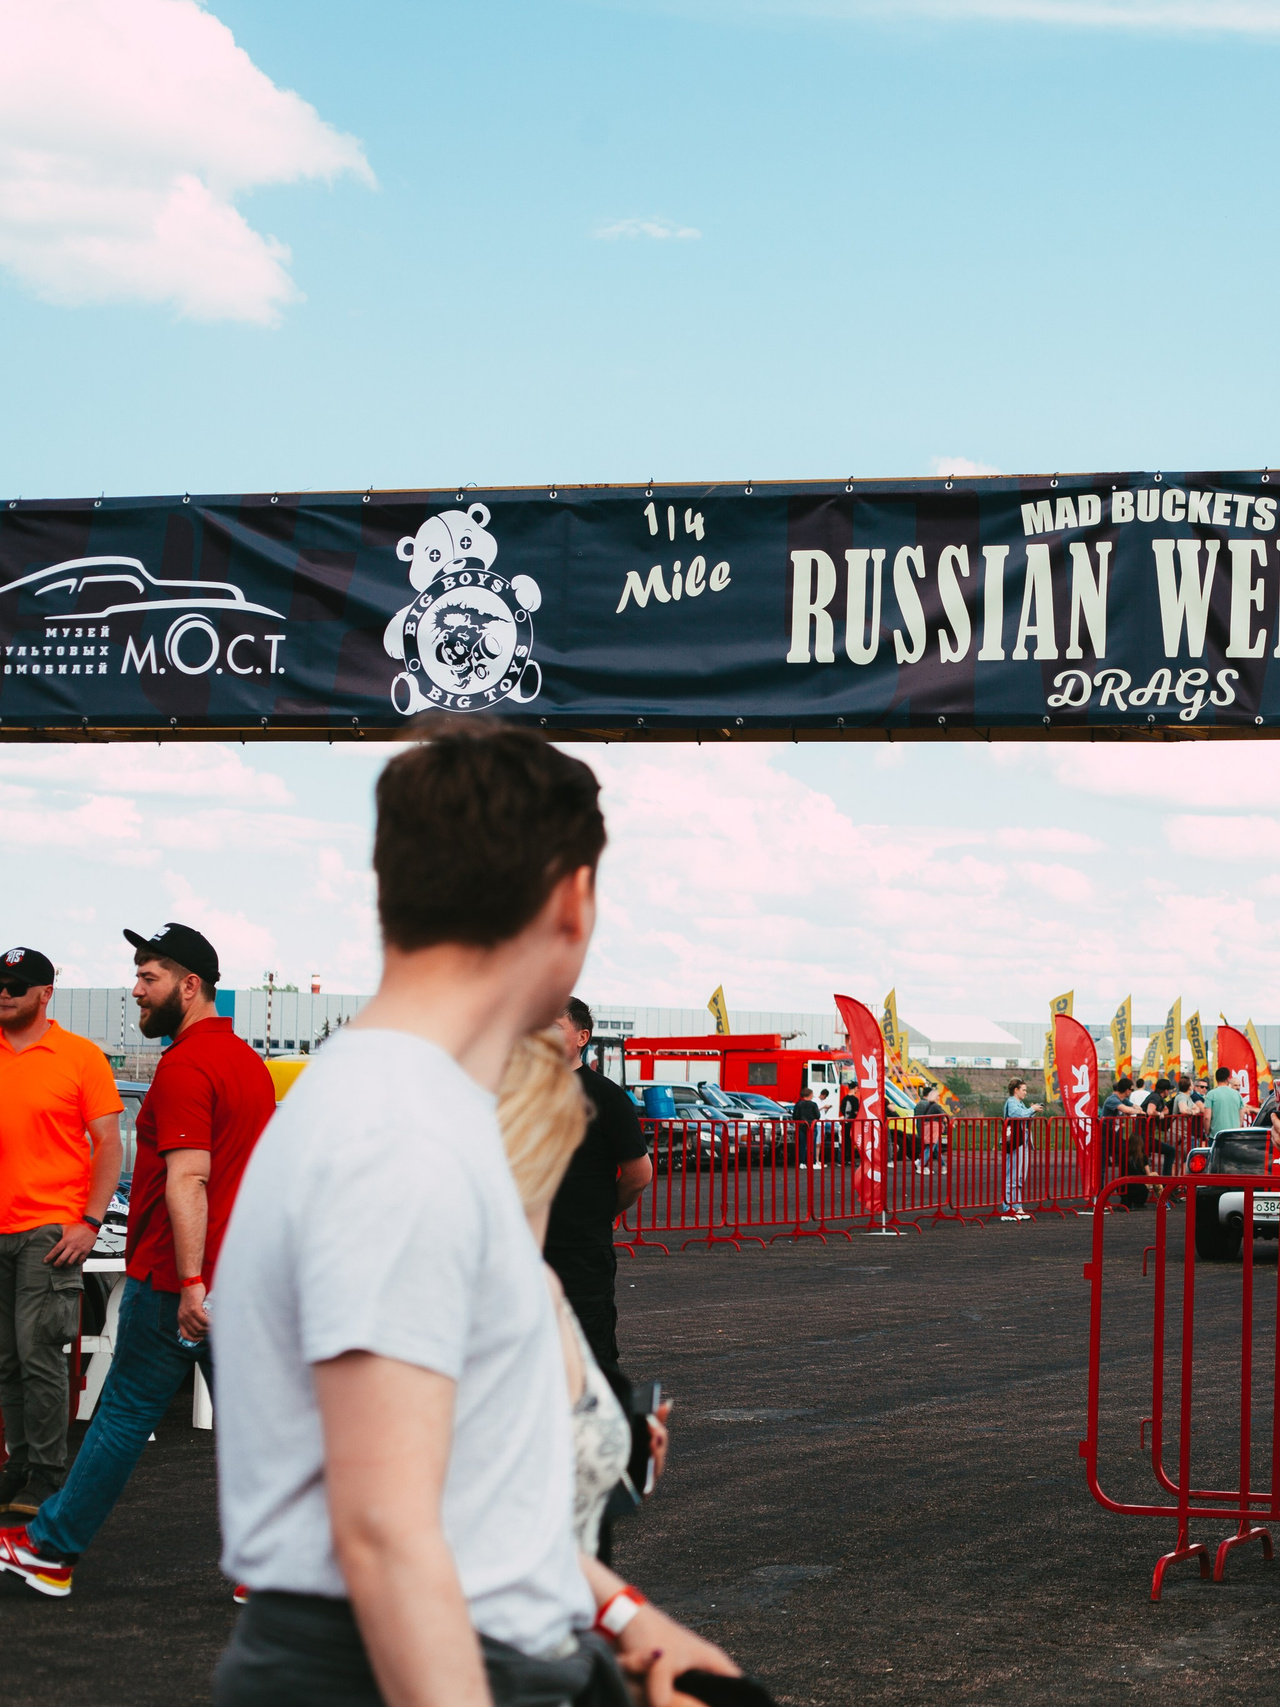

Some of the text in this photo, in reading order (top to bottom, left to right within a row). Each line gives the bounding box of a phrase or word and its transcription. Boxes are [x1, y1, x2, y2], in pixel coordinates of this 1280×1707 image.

[1021, 488, 1278, 536] MAD BUCKETS
[616, 555, 732, 614] Mile
[786, 541, 1113, 665] RUSSIAN
[45, 625, 110, 638] МУЗЕЙ
[405, 593, 434, 637] BIG
[0, 645, 109, 657] УЛЬТОВЫХ
[4, 663, 108, 675] ОМОБИЛЕЙ
[426, 644, 529, 708] BIG TOYS
[1046, 668, 1240, 722] DRAGS
